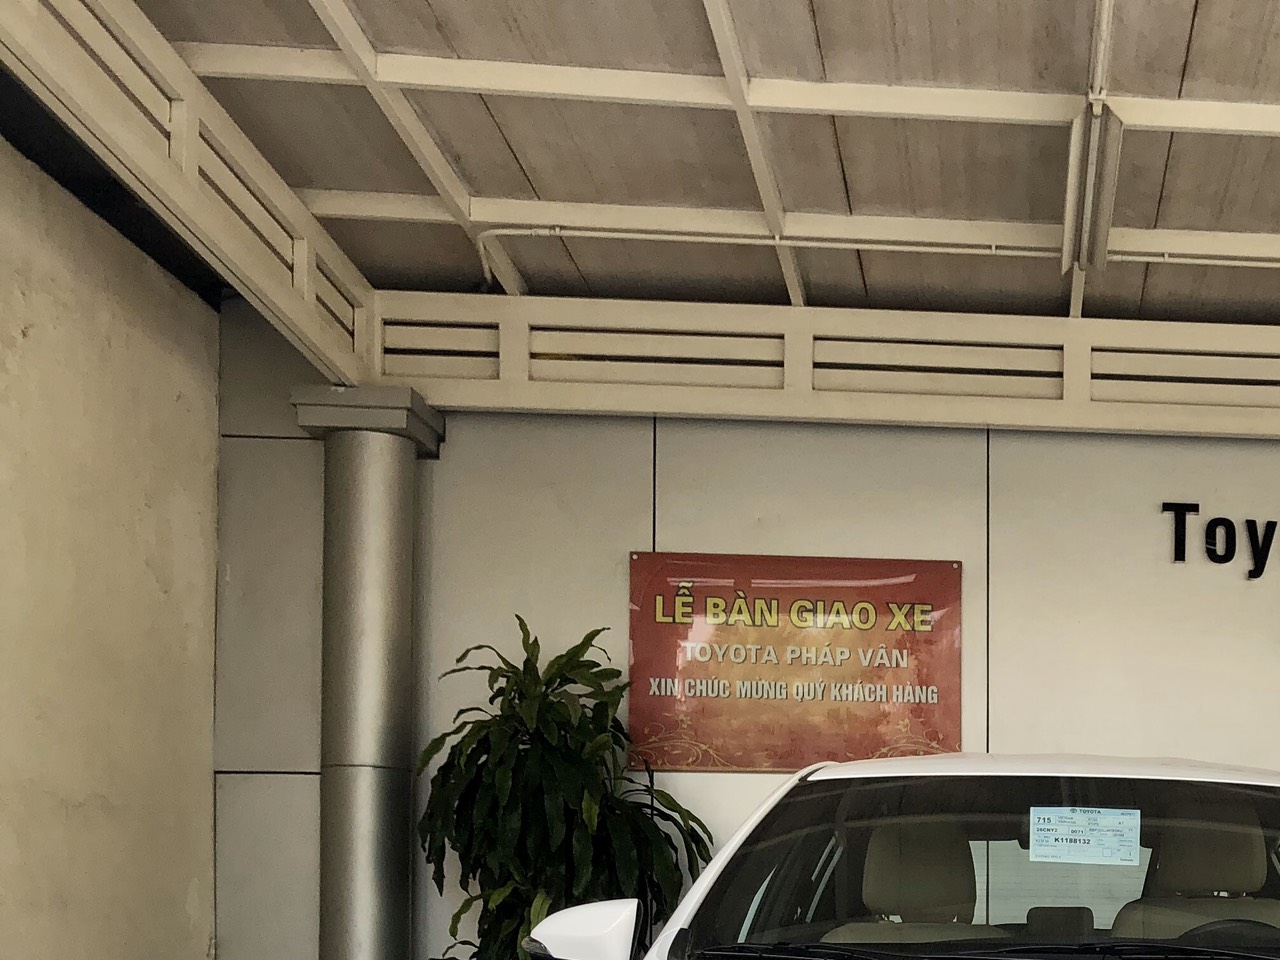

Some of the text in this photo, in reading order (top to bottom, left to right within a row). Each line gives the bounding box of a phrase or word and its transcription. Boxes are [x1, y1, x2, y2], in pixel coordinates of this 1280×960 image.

[654, 582, 934, 632] LỄ BÀN GIAO XE
[682, 641, 909, 668] TOYOTA PHÁP VÂN
[649, 677, 679, 696] XIN
[684, 675, 731, 699] CHÚC
[793, 677, 827, 702] QUÝ
[830, 679, 888, 703] KHÁCH
[892, 681, 939, 704] HÀNG
[1036, 816, 1052, 824] 715
